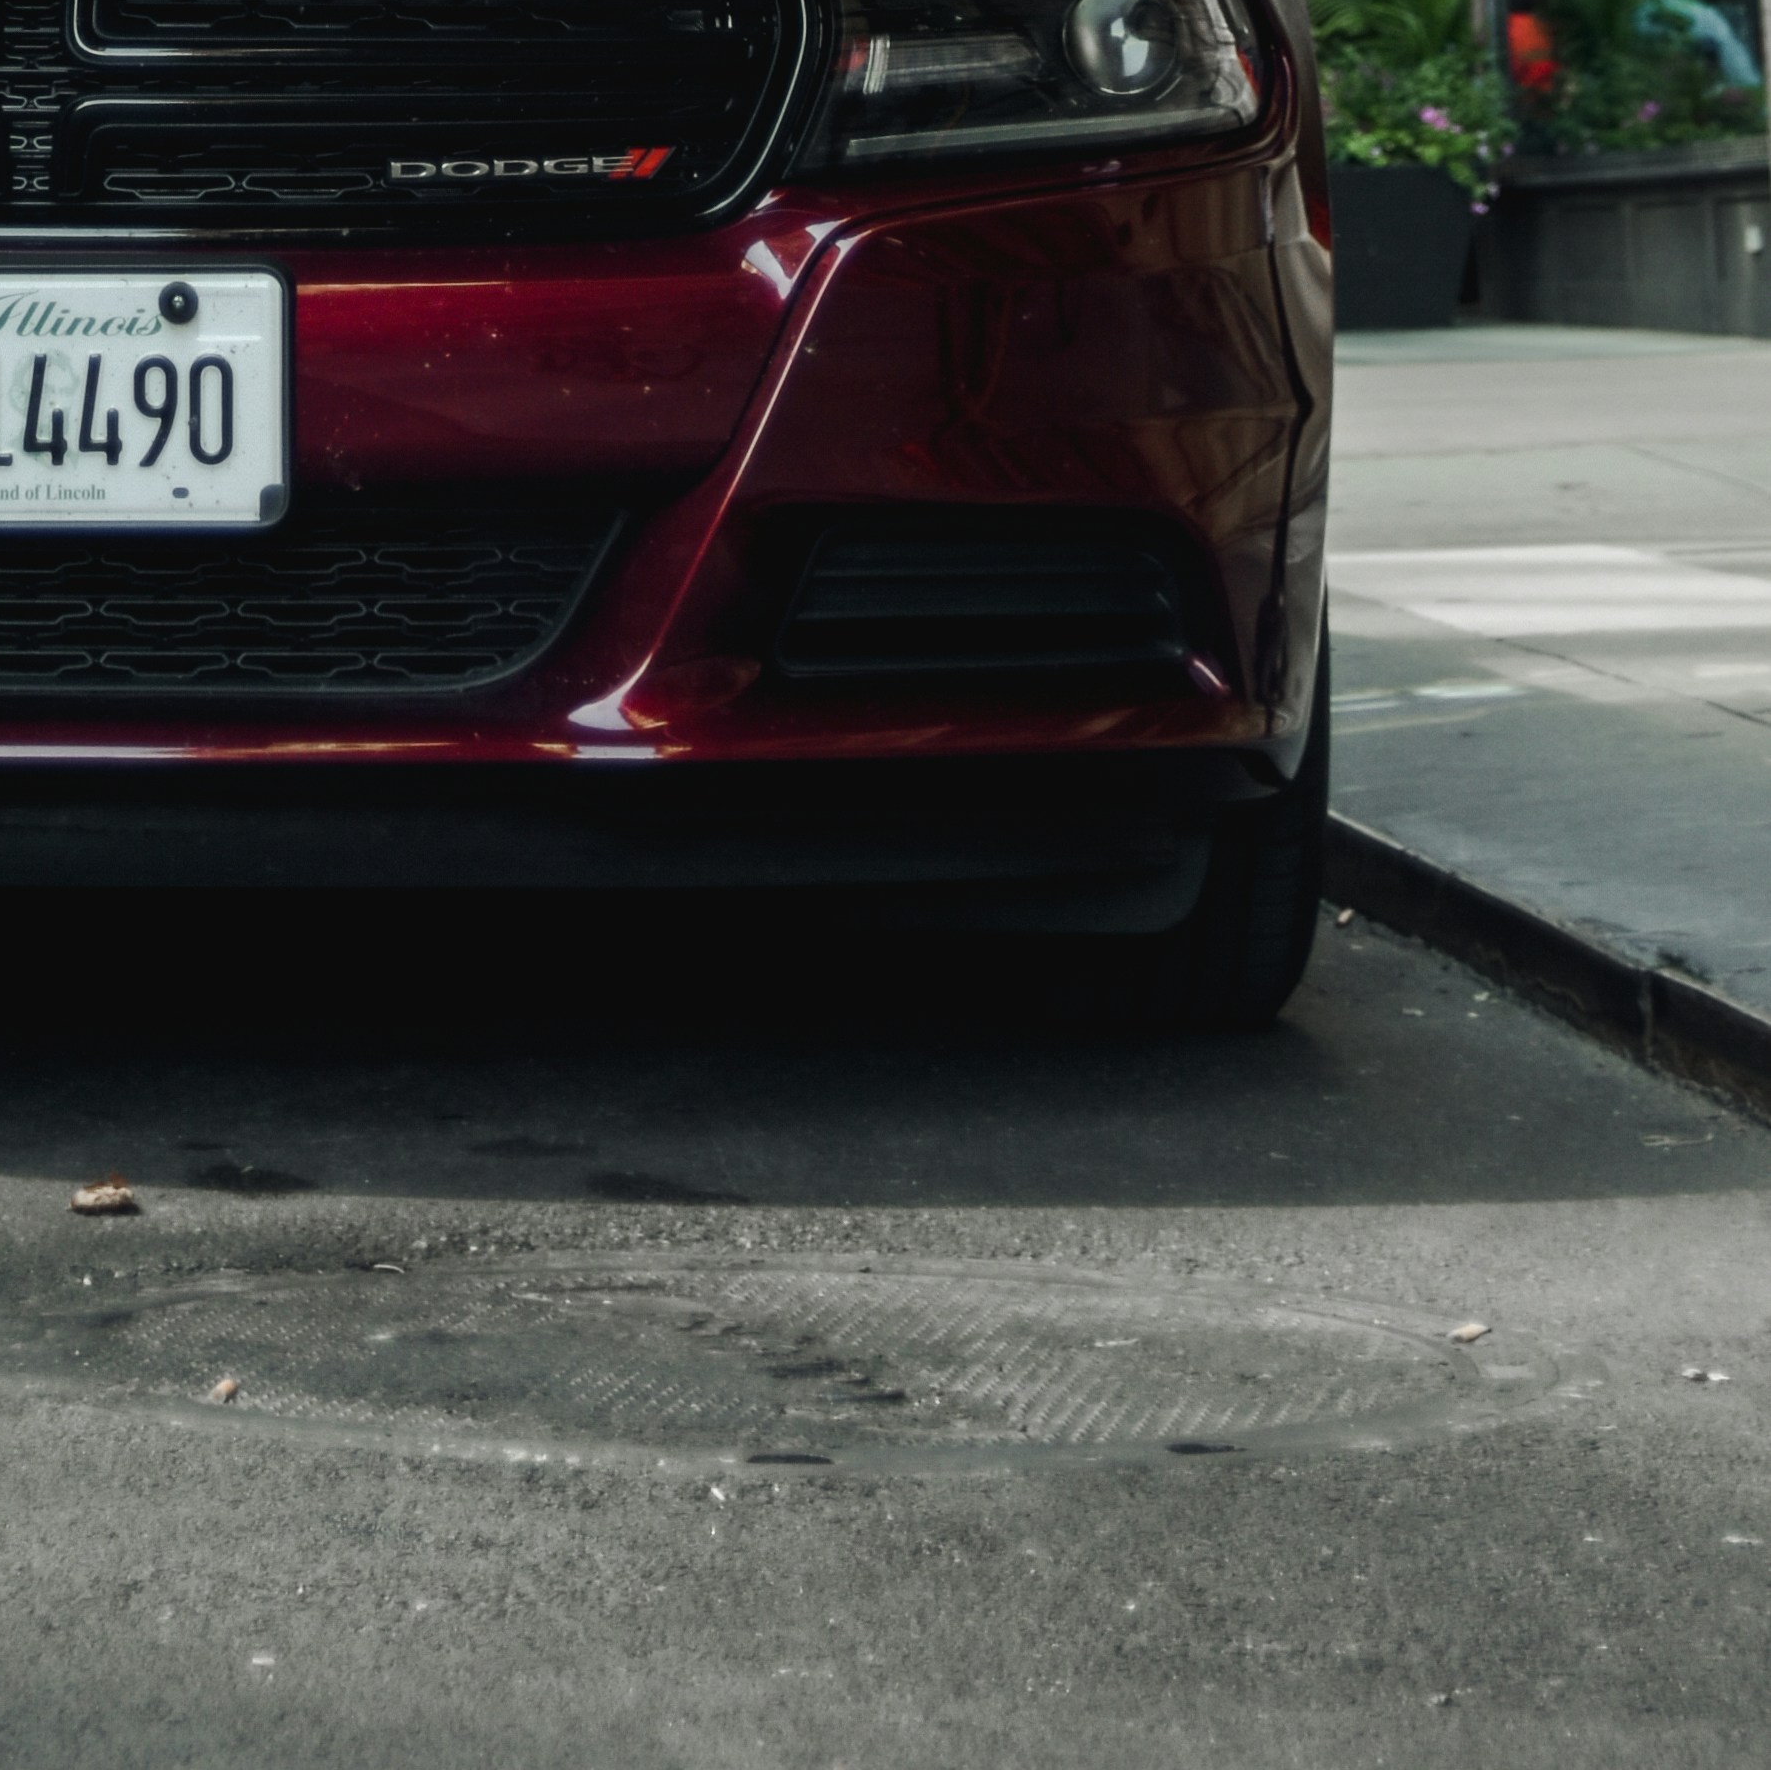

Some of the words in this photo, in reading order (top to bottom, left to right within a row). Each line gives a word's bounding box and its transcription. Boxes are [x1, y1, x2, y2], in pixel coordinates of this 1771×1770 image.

[390, 156, 634, 179] DODGE
[24, 484, 41, 502] of
[44, 484, 107, 502] Lincoln
